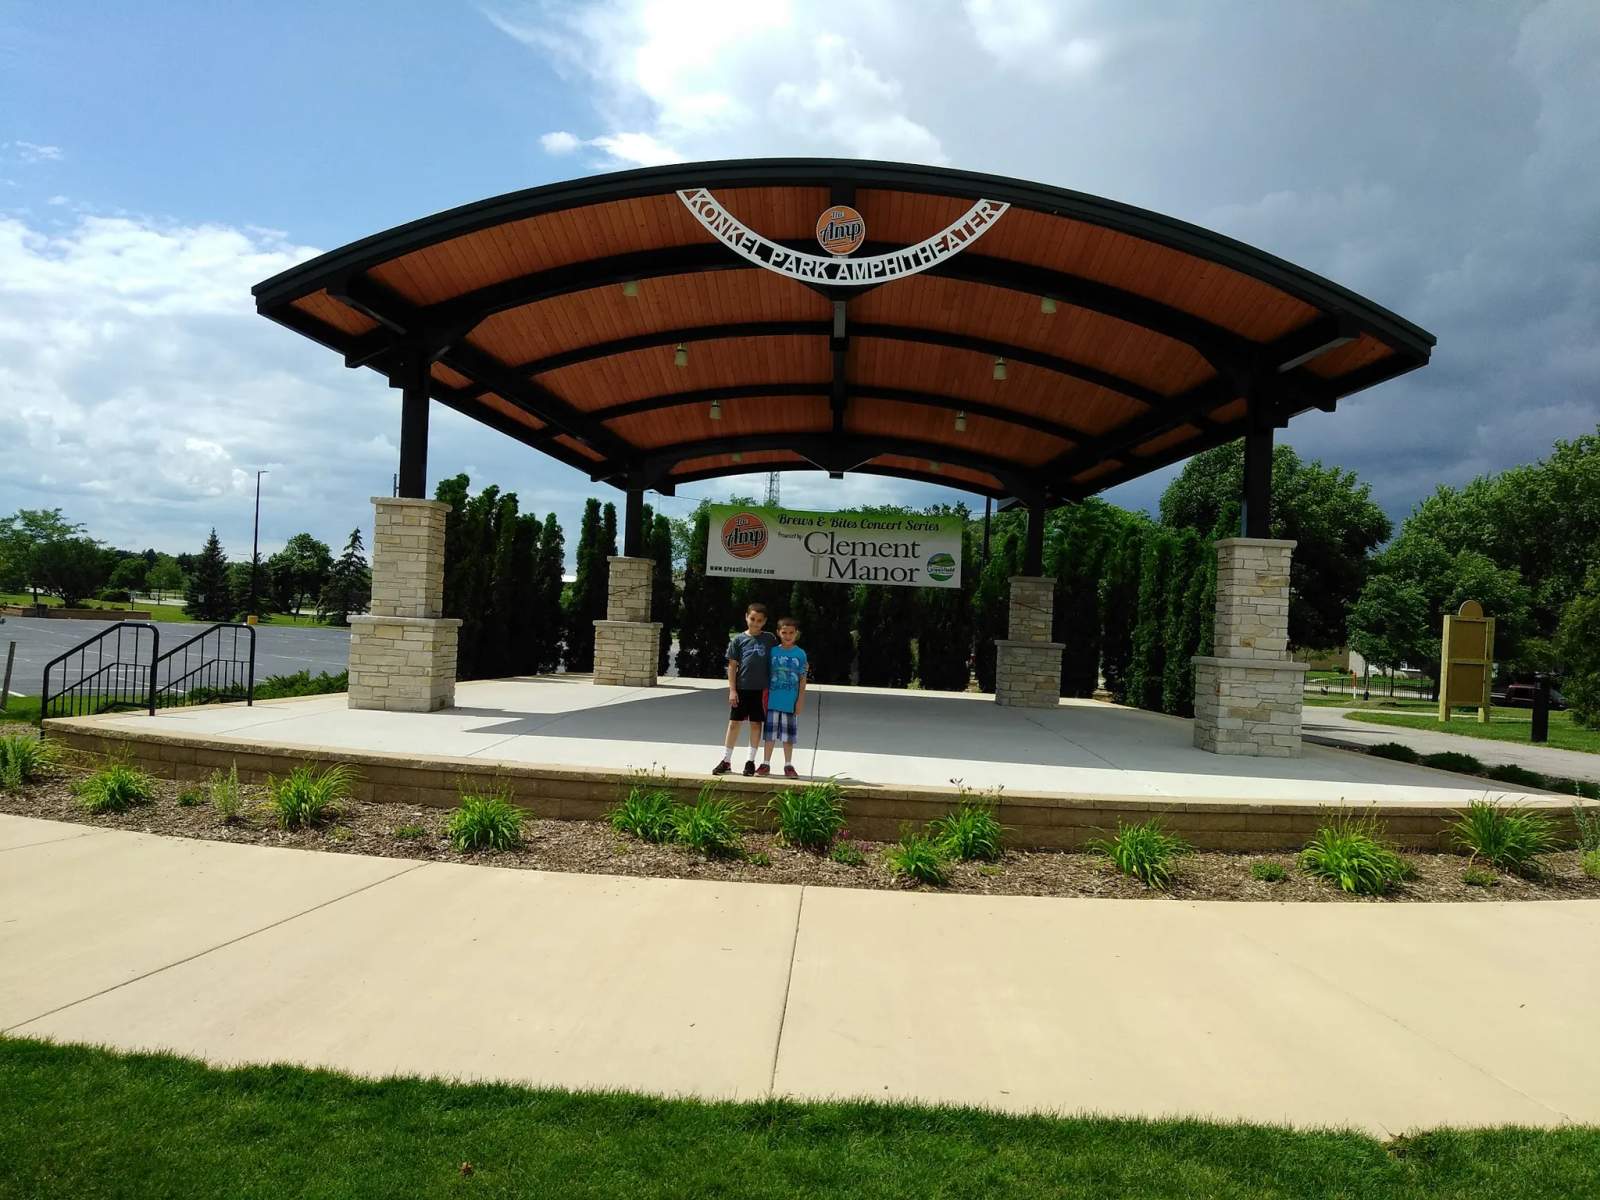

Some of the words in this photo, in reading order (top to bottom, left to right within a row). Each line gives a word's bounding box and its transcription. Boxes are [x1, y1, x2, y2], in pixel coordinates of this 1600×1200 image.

[689, 190, 763, 261] KONKEL
[770, 250, 829, 280] PARK
[835, 201, 998, 281] AMPHITHEATER
[820, 221, 862, 243] Amp
[777, 513, 813, 526] Brews
[816, 516, 825, 527] &
[829, 517, 858, 529] Bites
[860, 519, 903, 530] Concert
[905, 520, 940, 531] Series
[725, 527, 764, 547] Amp
[804, 531, 921, 559] Clement
[825, 557, 920, 583] Manor
